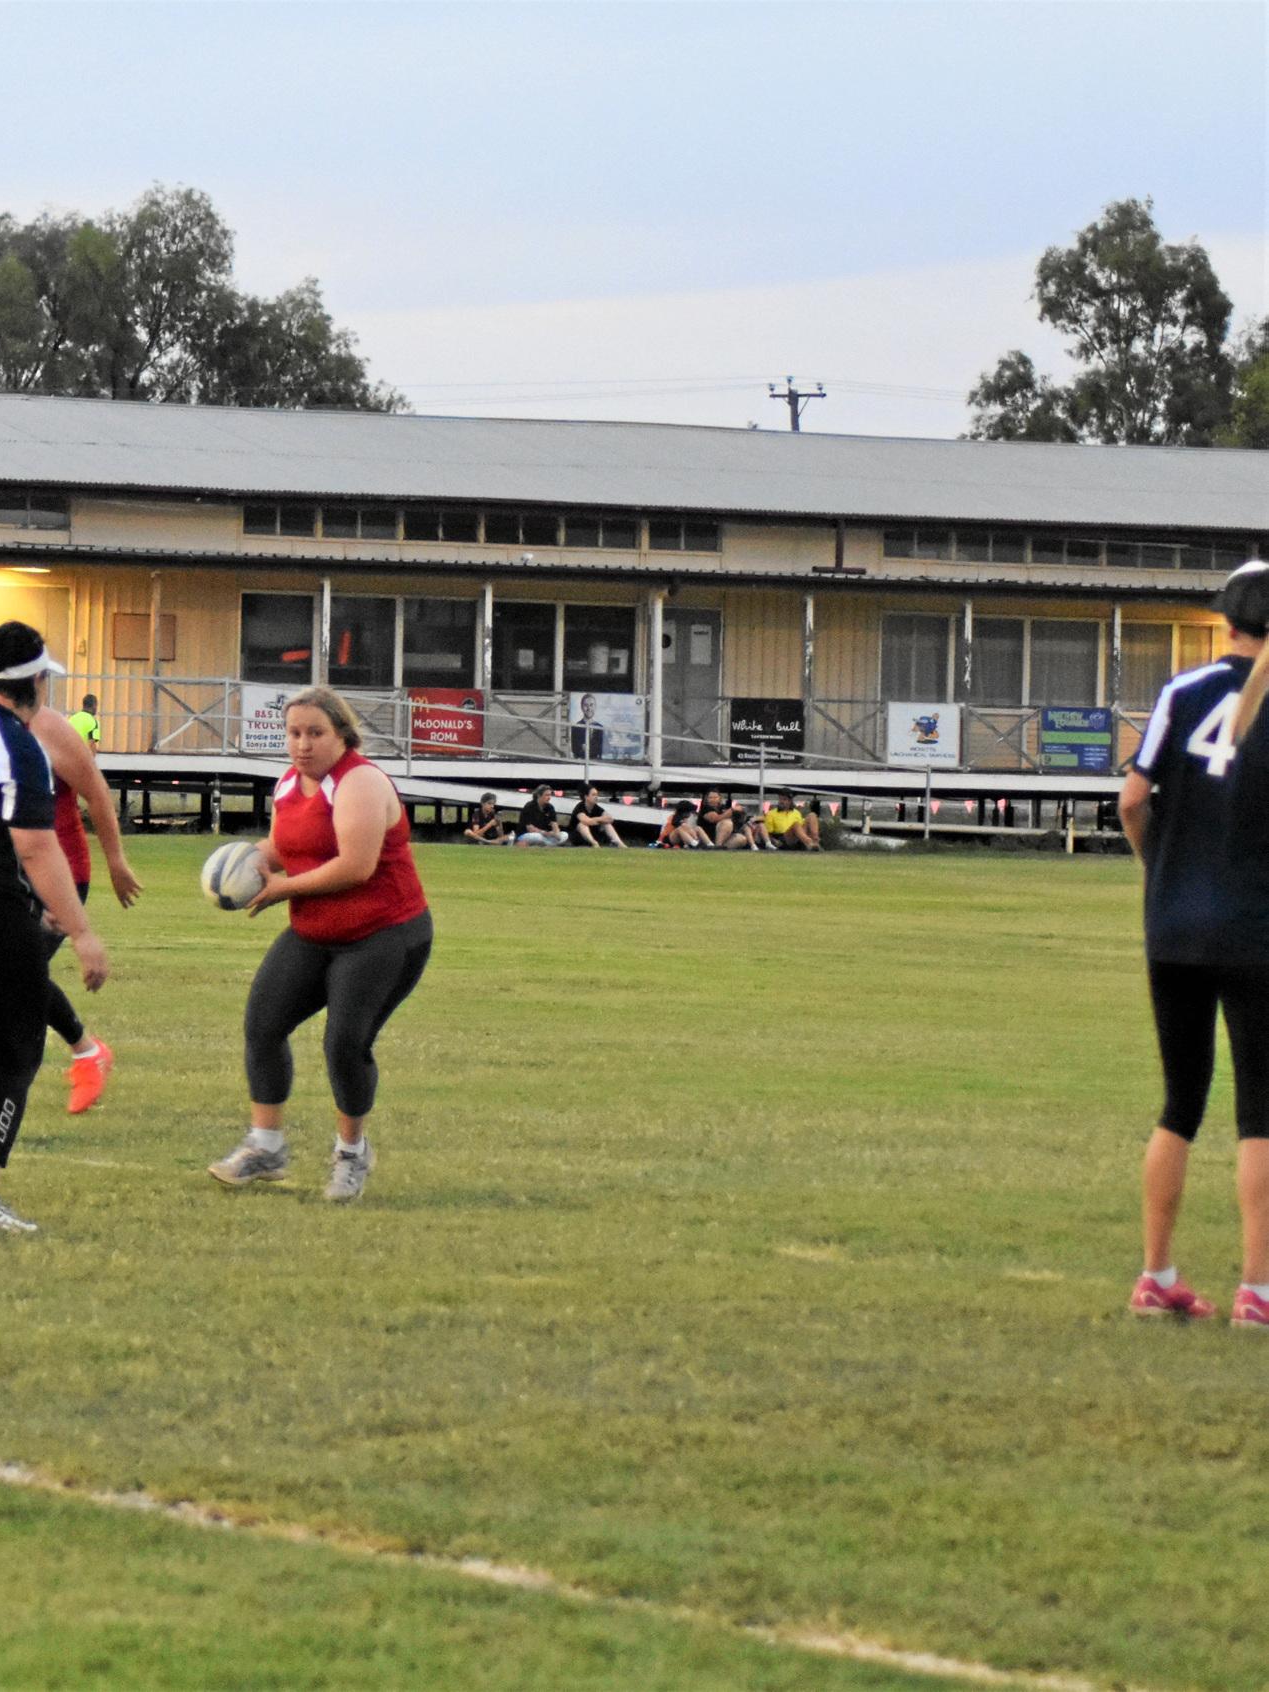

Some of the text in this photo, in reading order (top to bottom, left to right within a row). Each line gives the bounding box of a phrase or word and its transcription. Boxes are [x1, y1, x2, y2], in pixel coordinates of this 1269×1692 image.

[255, 710, 273, 718] B&S
[413, 719, 474, 730] McDONALD'S
[732, 719, 764, 731] White
[430, 731, 459, 742] ROMA
[1186, 692, 1242, 777] 4
